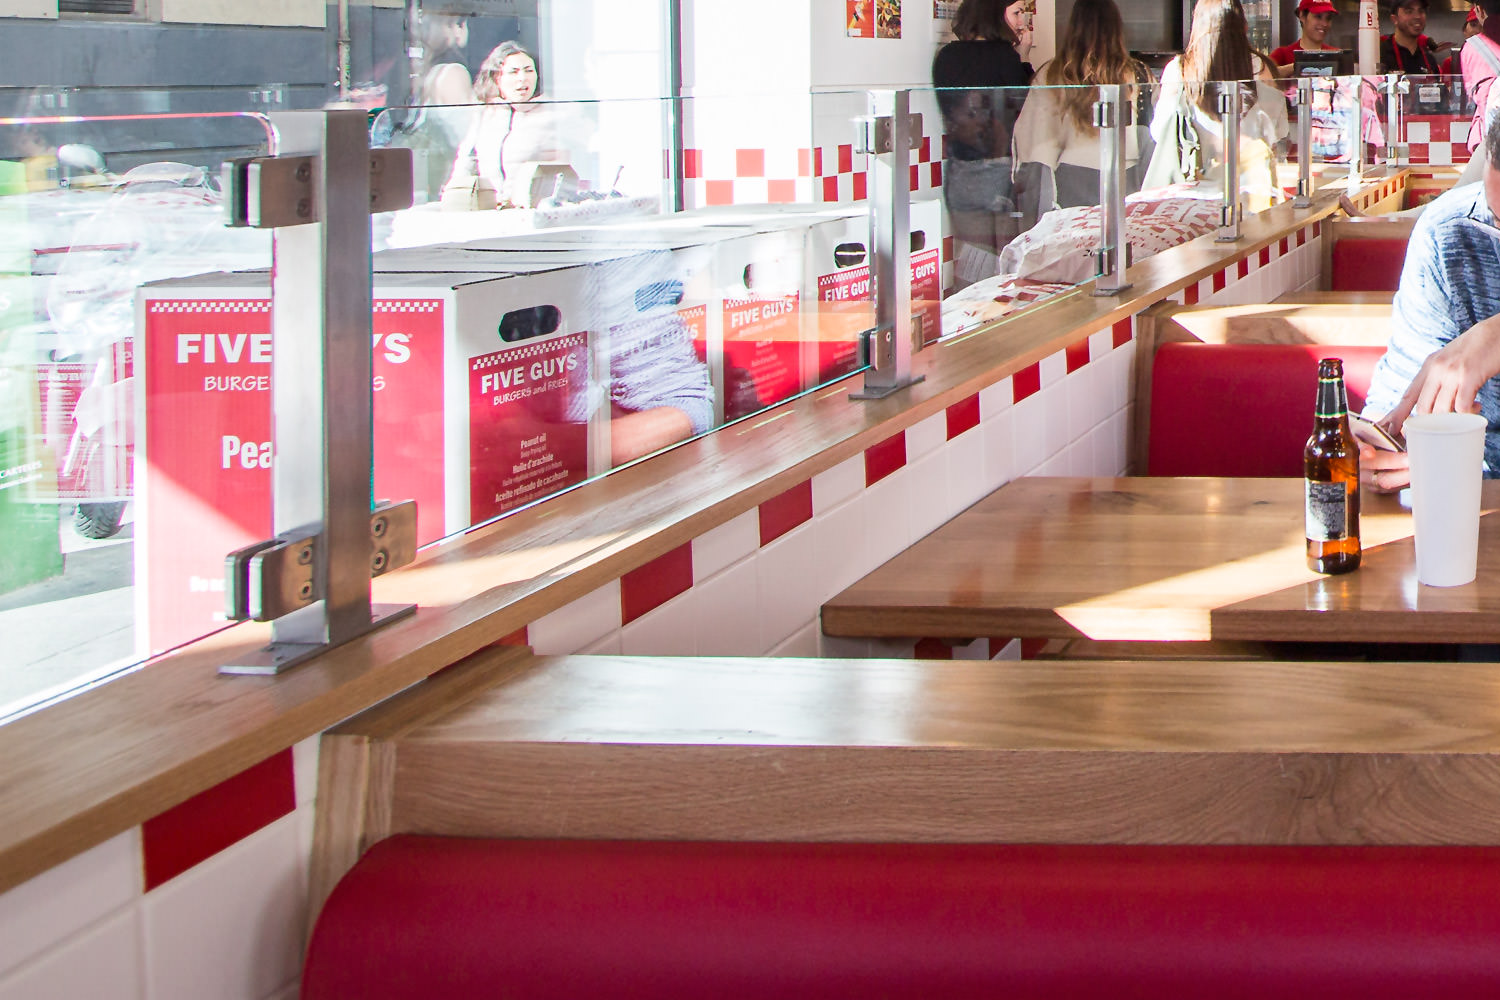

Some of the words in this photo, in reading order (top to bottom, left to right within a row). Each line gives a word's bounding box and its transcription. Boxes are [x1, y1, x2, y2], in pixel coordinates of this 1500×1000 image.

[916, 262, 936, 278] GUYS
[824, 286, 849, 303] FIVE
[850, 278, 871, 296] GUY
[731, 306, 760, 329] FIVE
[762, 298, 794, 320] GUYS
[177, 333, 273, 364] FIVE
[204, 375, 272, 391] BURGE
[481, 365, 525, 394] FIVE
[530, 352, 578, 380] GUYS
[493, 386, 532, 406] BURGERS
[533, 381, 547, 395] and
[547, 377, 569, 392] FRIES
[222, 435, 273, 469] Pea
[520, 435, 539, 449] Peanut
